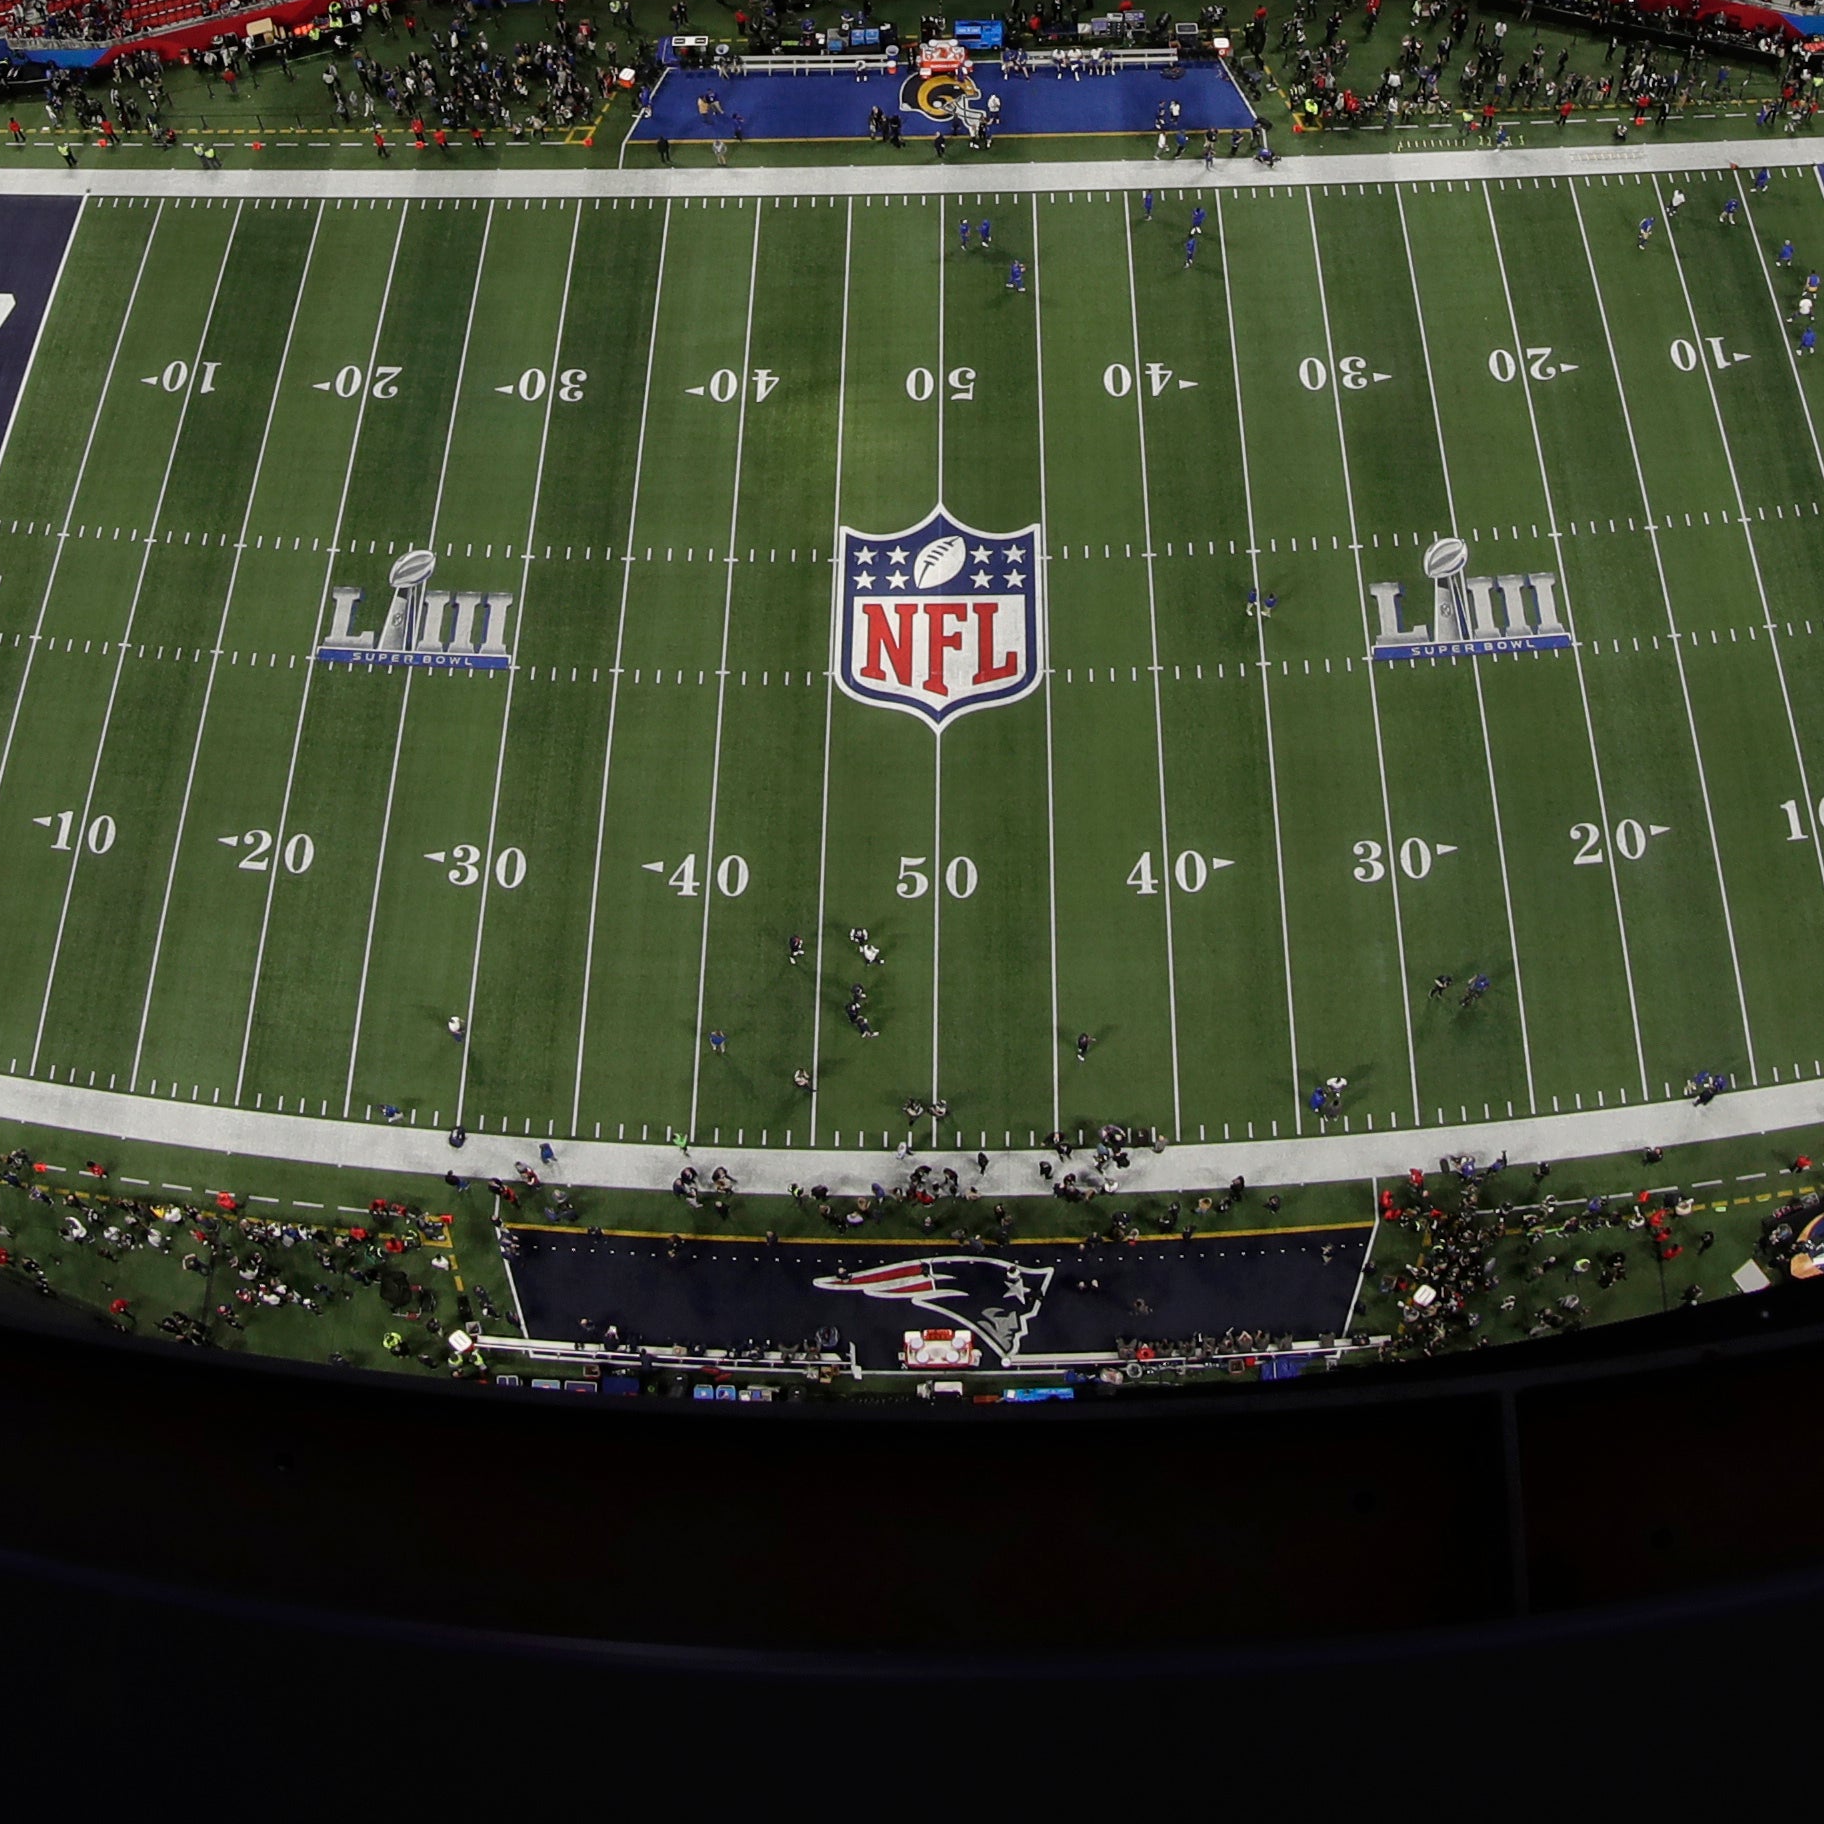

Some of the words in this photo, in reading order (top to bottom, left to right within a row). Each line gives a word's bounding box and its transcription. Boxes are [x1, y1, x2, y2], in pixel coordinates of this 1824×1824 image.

[161, 360, 221, 394] 10
[339, 363, 403, 400] 20
[521, 367, 588, 403] 30
[708, 367, 779, 404] 40
[905, 367, 978, 403] 50
[1103, 361, 1173, 398] 40
[1298, 356, 1368, 392] 30
[1488, 346, 1558, 382] 20
[1669, 337, 1732, 372] 10
[352, 651, 416, 665] SUPER
[422, 653, 474, 668] BOWL
[859, 600, 1020, 696] NFL
[1409, 643, 1474, 657] SUPER
[1483, 638, 1536, 653] BOWL
[51, 810, 116, 856] 10
[237, 829, 315, 876] 20
[444, 844, 526, 889] 30
[666, 853, 750, 898] 40
[896, 854, 978, 899] 50
[1126, 849, 1208, 895] 40
[1352, 836, 1432, 882] 30
[1569, 818, 1647, 866] 20
